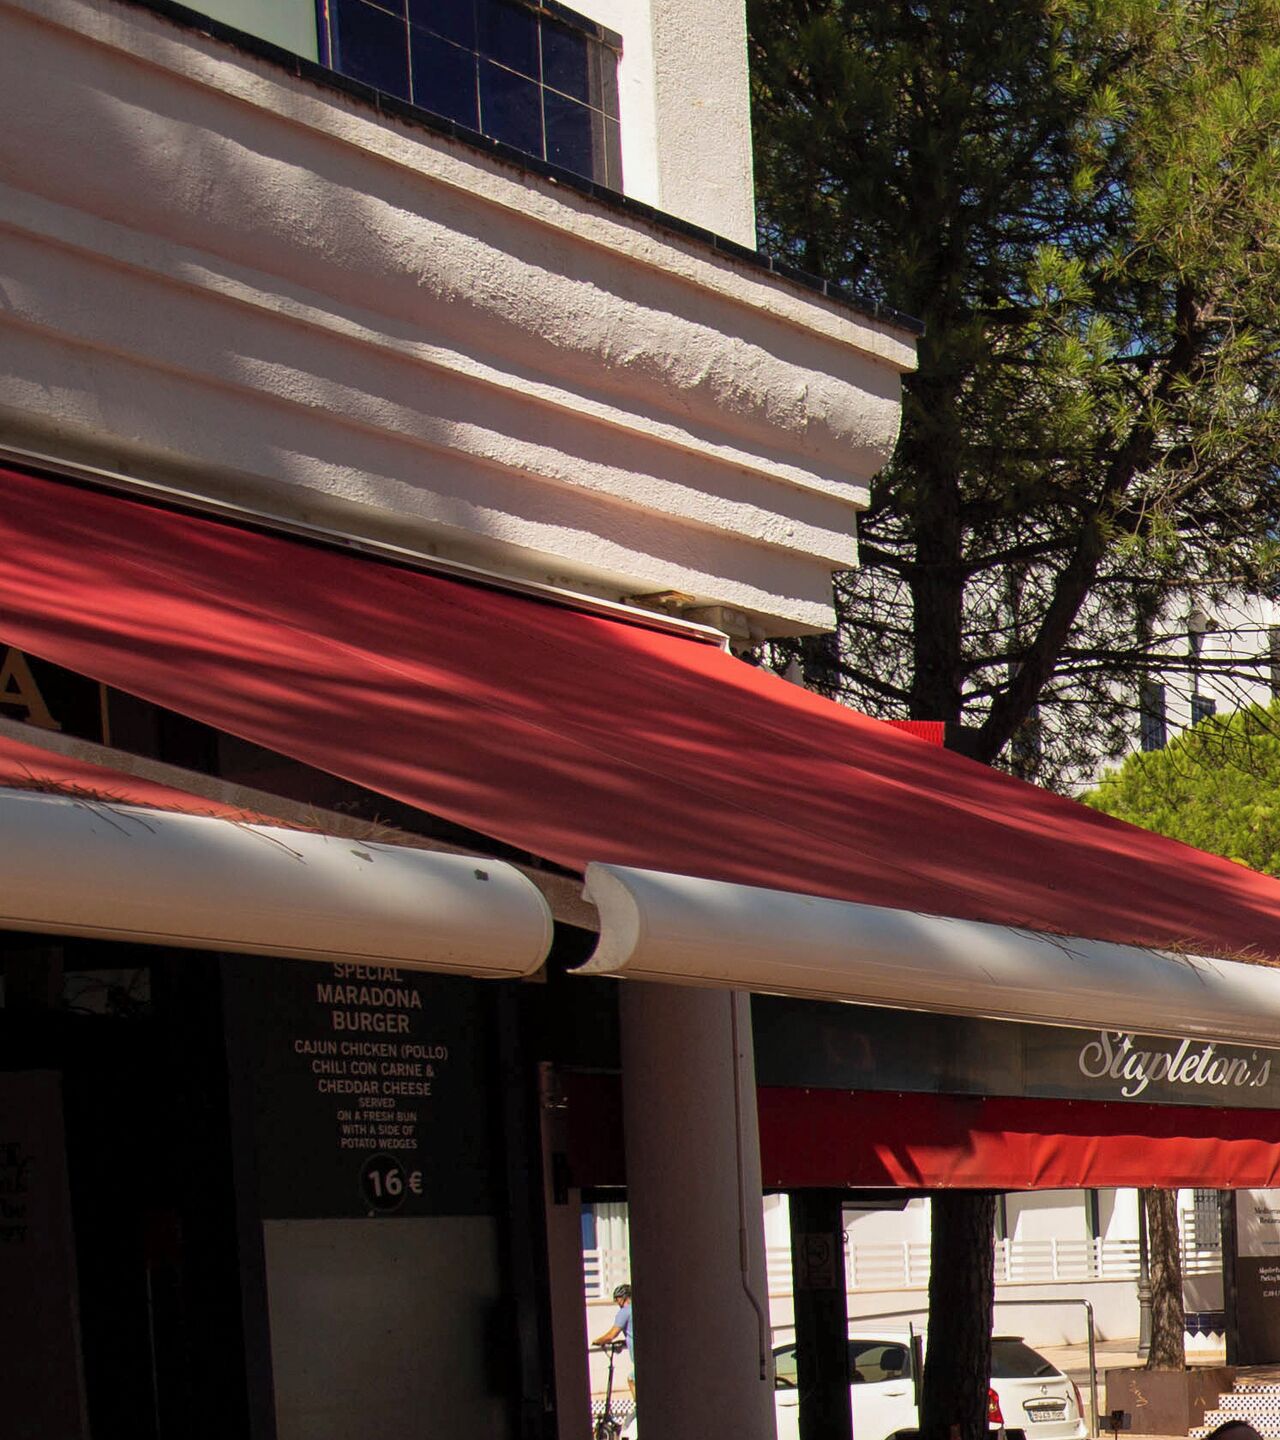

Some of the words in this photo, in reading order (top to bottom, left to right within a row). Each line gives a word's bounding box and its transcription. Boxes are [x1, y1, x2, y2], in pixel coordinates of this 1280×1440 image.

[333, 962, 404, 982] SPECIAL
[316, 983, 422, 1009] MARADONA
[332, 1010, 410, 1033] BURGER
[294, 1039, 337, 1055] CAJUN
[340, 1041, 398, 1058] CHICKEN
[401, 1044, 449, 1061] (POLLO)
[312, 1059, 346, 1074] CHILI
[350, 1060, 377, 1075] CON
[380, 1062, 423, 1077] CARNE
[426, 1064, 435, 1077] &
[318, 1078, 379, 1095] CHEDDAR
[382, 1081, 432, 1096] CHEESE
[359, 1097, 396, 1109] SERVED
[337, 1110, 351, 1121] ON
[363, 1111, 394, 1122] FRESH
[397, 1111, 417, 1123] BUN
[342, 1124, 367, 1135] WITH
[369, 1124, 376, 1135] A
[378, 1124, 400, 1136] SIDE
[402, 1125, 414, 1136] OF
[340, 1138, 377, 1149] POTATO
[378, 1138, 418, 1149] WEDGES
[368, 1168, 402, 1197] 16
